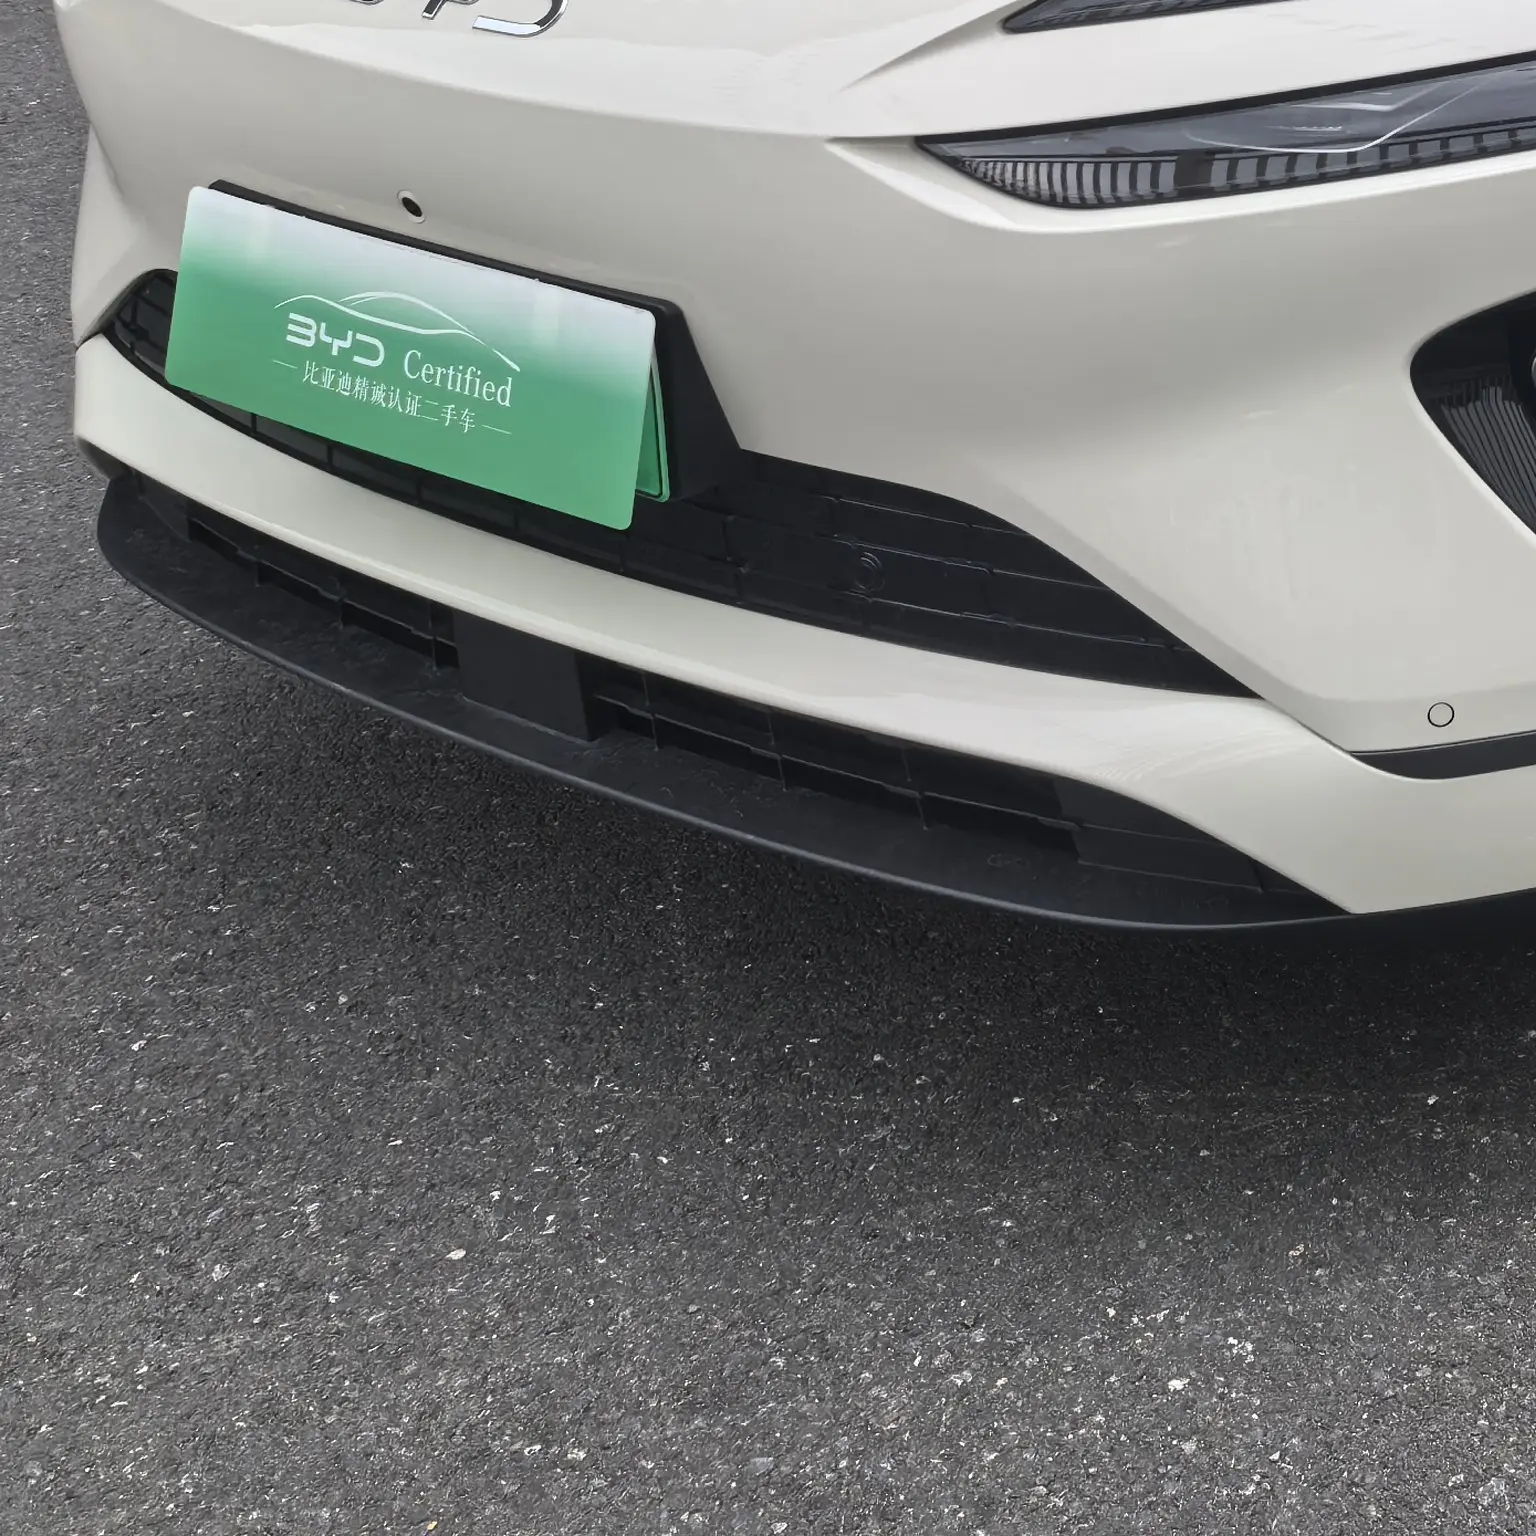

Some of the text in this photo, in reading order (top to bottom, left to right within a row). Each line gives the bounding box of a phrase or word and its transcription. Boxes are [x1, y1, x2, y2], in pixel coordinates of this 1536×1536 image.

[286, 312, 513, 408] BYD Certified
[302, 359, 477, 434] 比亚迪精诚认证二手车
